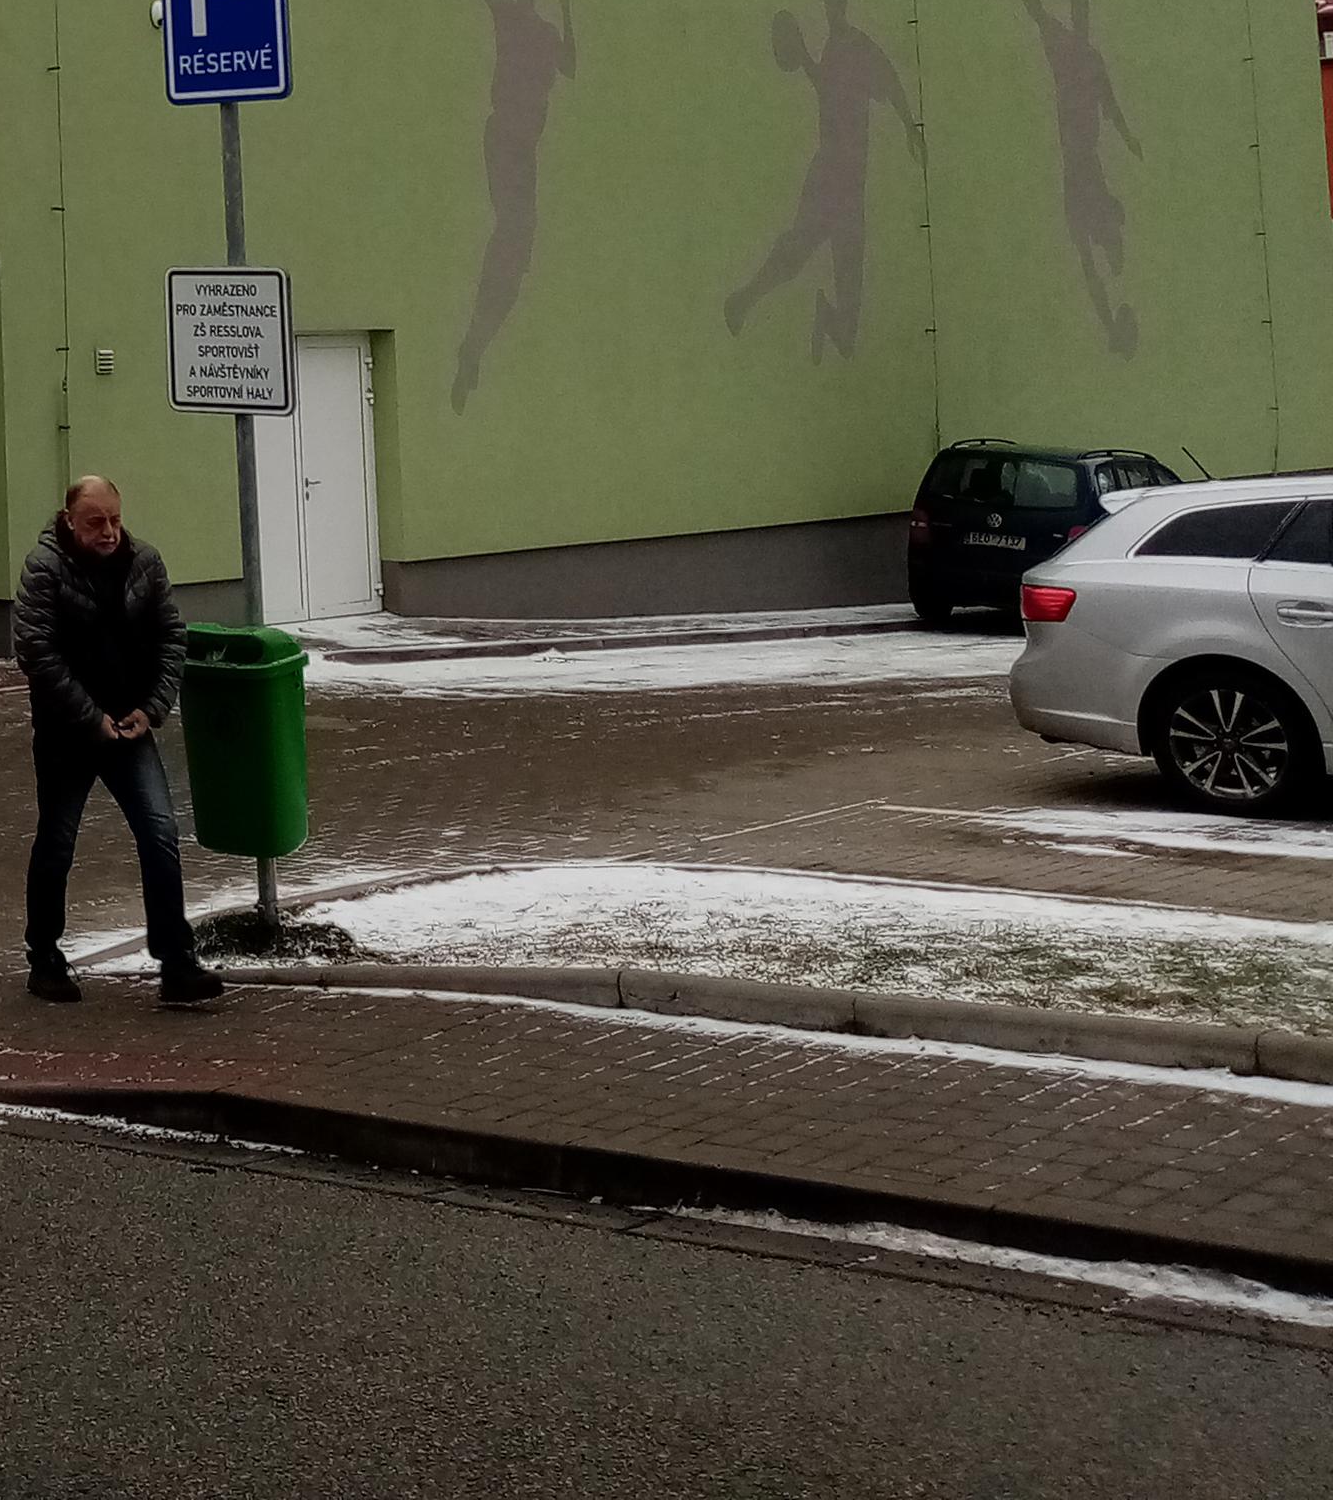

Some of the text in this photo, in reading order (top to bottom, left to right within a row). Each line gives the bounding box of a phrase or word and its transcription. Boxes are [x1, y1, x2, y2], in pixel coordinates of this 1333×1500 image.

[178, 43, 273, 76] RÉSERVÉ
[195, 284, 257, 297] VYHRAZENO
[176, 301, 278, 318] PRO ZAMĚSTNANCE
[193, 322, 206, 337] ZŠ
[198, 343, 260, 359] SPORTOVIŠŤ
[189, 363, 270, 380] A NÁVŠTĚVNÍKY
[186, 384, 274, 400] SPORTOVNÍ HALY
